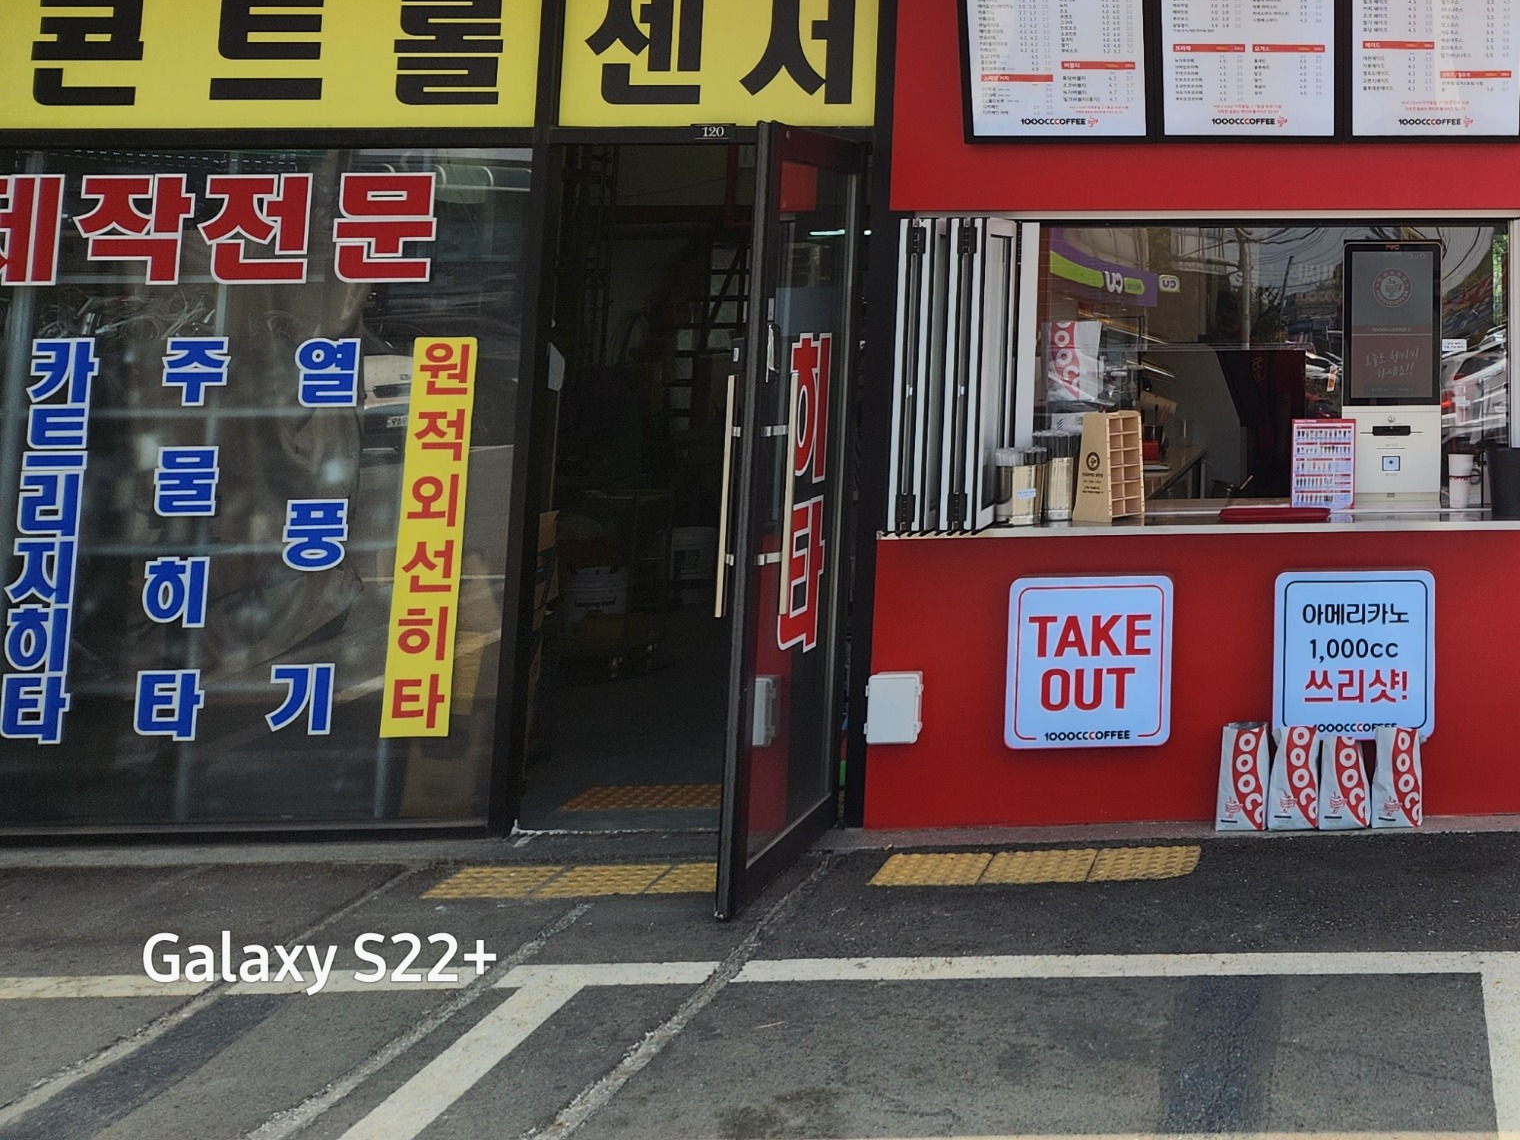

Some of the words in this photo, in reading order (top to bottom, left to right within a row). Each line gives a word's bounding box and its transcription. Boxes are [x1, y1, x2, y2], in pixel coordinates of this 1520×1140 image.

[701, 124, 725, 139] 120
[1399, 118, 1461, 126] 1000CCCOFFEE
[1, 338, 99, 746] 카트리지히타
[133, 336, 231, 742] 주물히타
[264, 338, 362, 737] 열풍기
[390, 341, 472, 731] 원적외선히타
[1302, 603, 1410, 626] 아메리카노
[1029, 614, 1152, 658] TAKE
[1309, 638, 1399, 663] 1,000cc
[1040, 667, 1135, 712] OUT
[1304, 669, 1408, 705] 쓰리샷!
[1044, 730, 1130, 742] 1000CCCOFFEE
